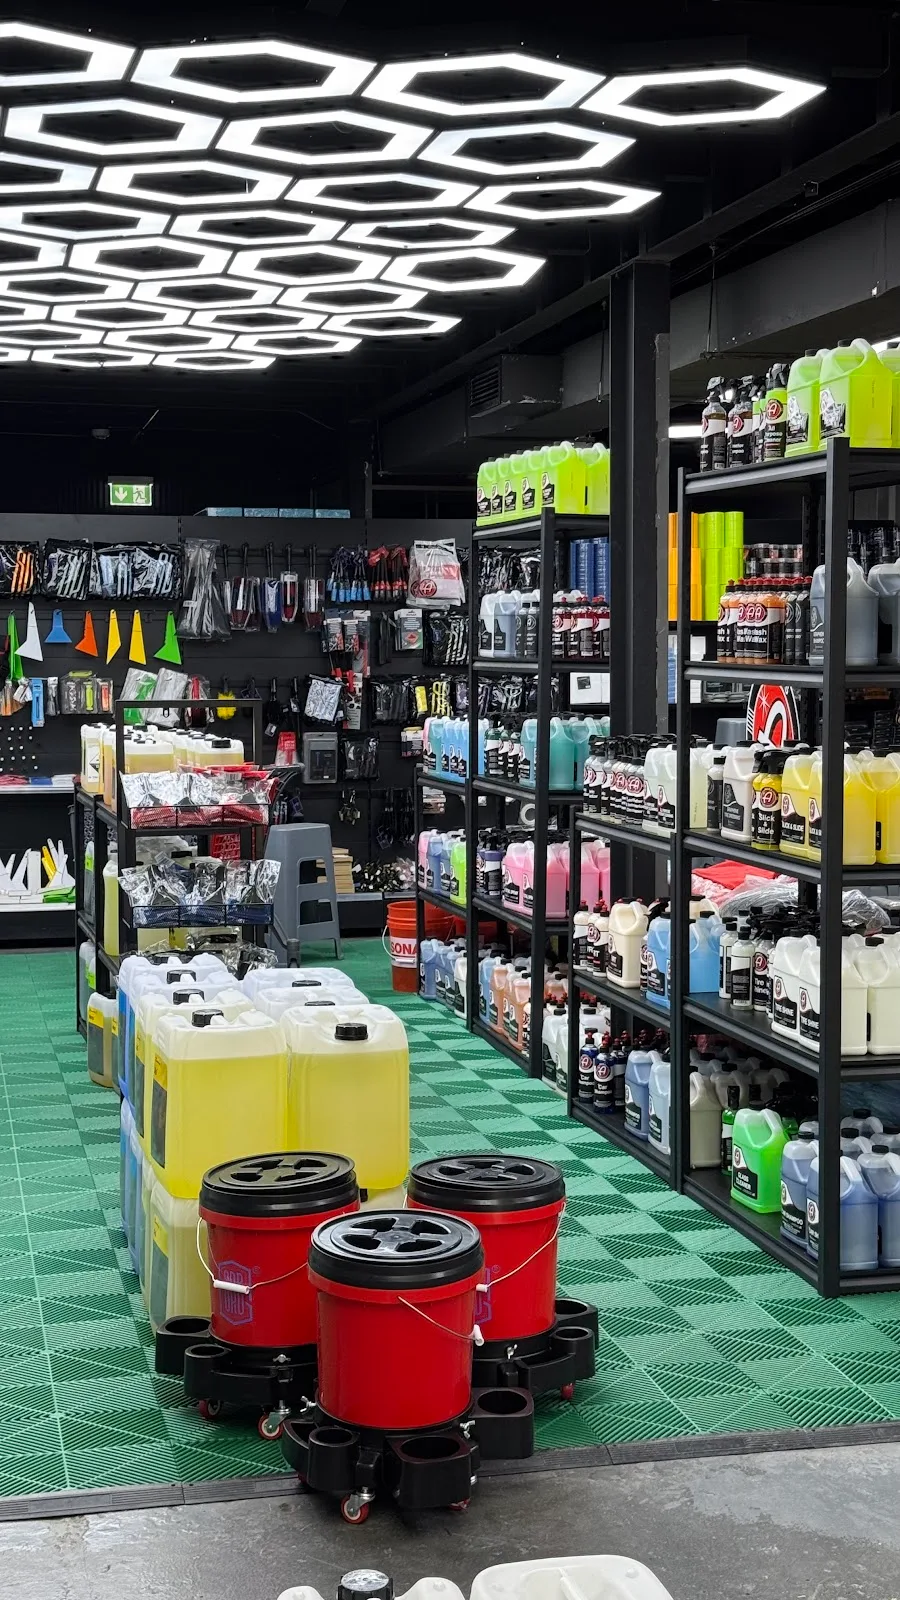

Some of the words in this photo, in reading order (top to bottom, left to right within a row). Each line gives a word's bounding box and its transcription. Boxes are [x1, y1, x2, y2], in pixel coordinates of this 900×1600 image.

[758, 812, 775, 822] Slick
[757, 826, 774, 835] Slide
[391, 942, 417, 955] SONA
